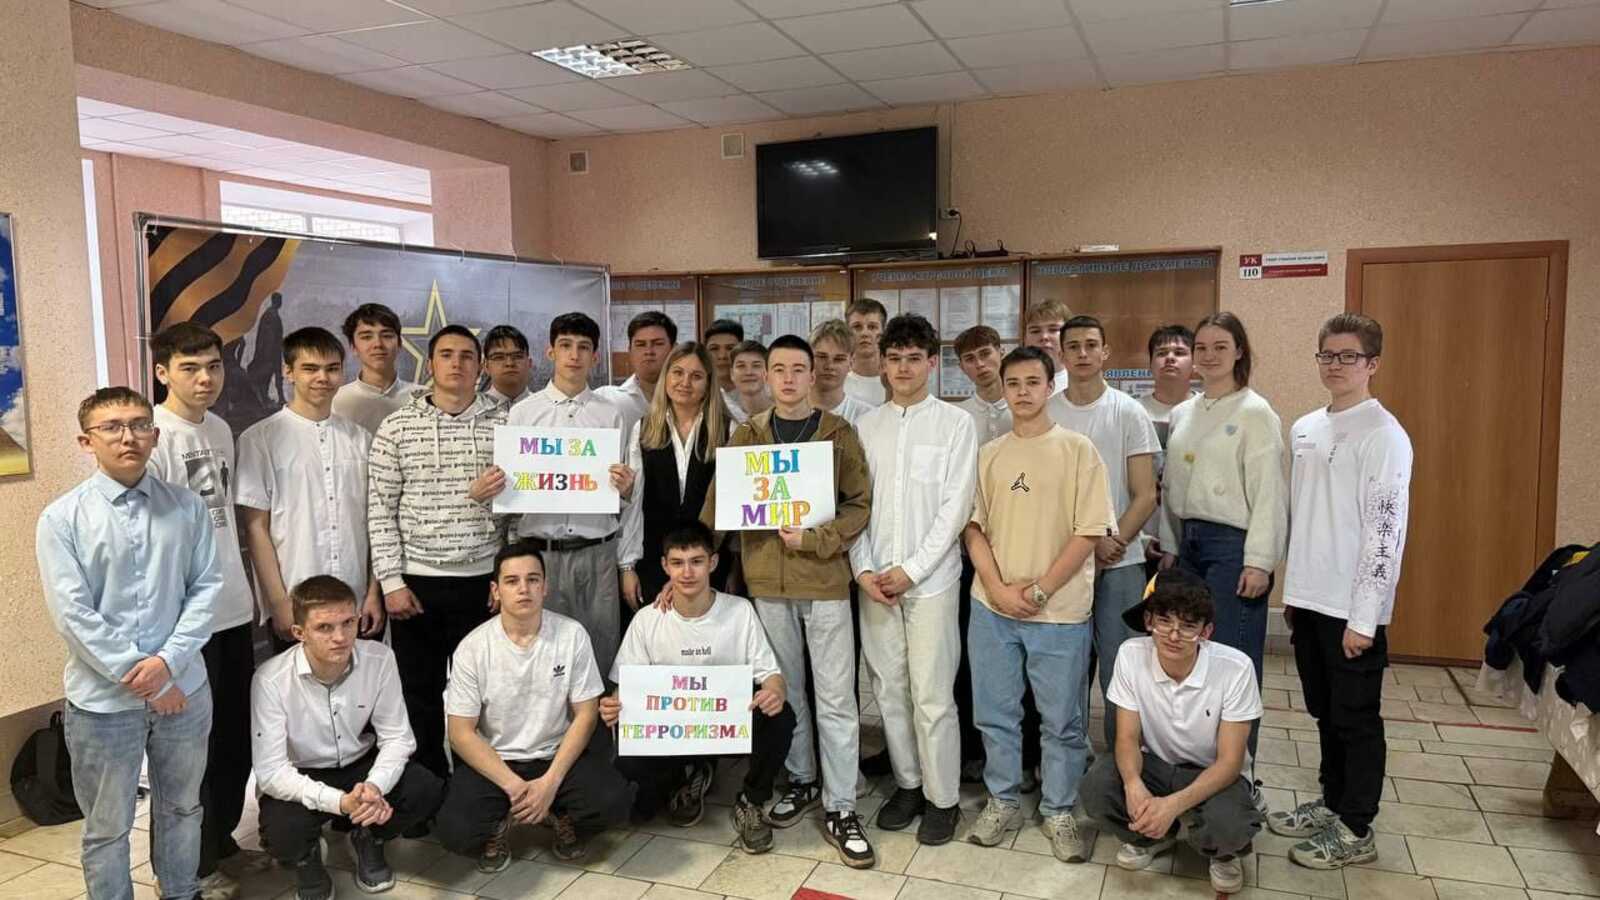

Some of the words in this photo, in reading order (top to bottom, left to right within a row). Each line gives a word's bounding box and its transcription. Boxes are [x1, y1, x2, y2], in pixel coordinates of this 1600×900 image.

[1244, 256, 1258, 265] УК
[1243, 268, 1259, 277] 110
[519, 437, 562, 457] МЫ
[568, 439, 597, 457] ЗА
[744, 448, 800, 476] МЫ
[513, 471, 598, 491] ЖИЗНЬ
[753, 475, 791, 501] ЗА
[741, 501, 811, 527] МИР
[672, 675, 707, 690] МЫ
[646, 695, 728, 712] ПРОТИВ
[621, 724, 749, 739] ТЕРРОРИЗМА
